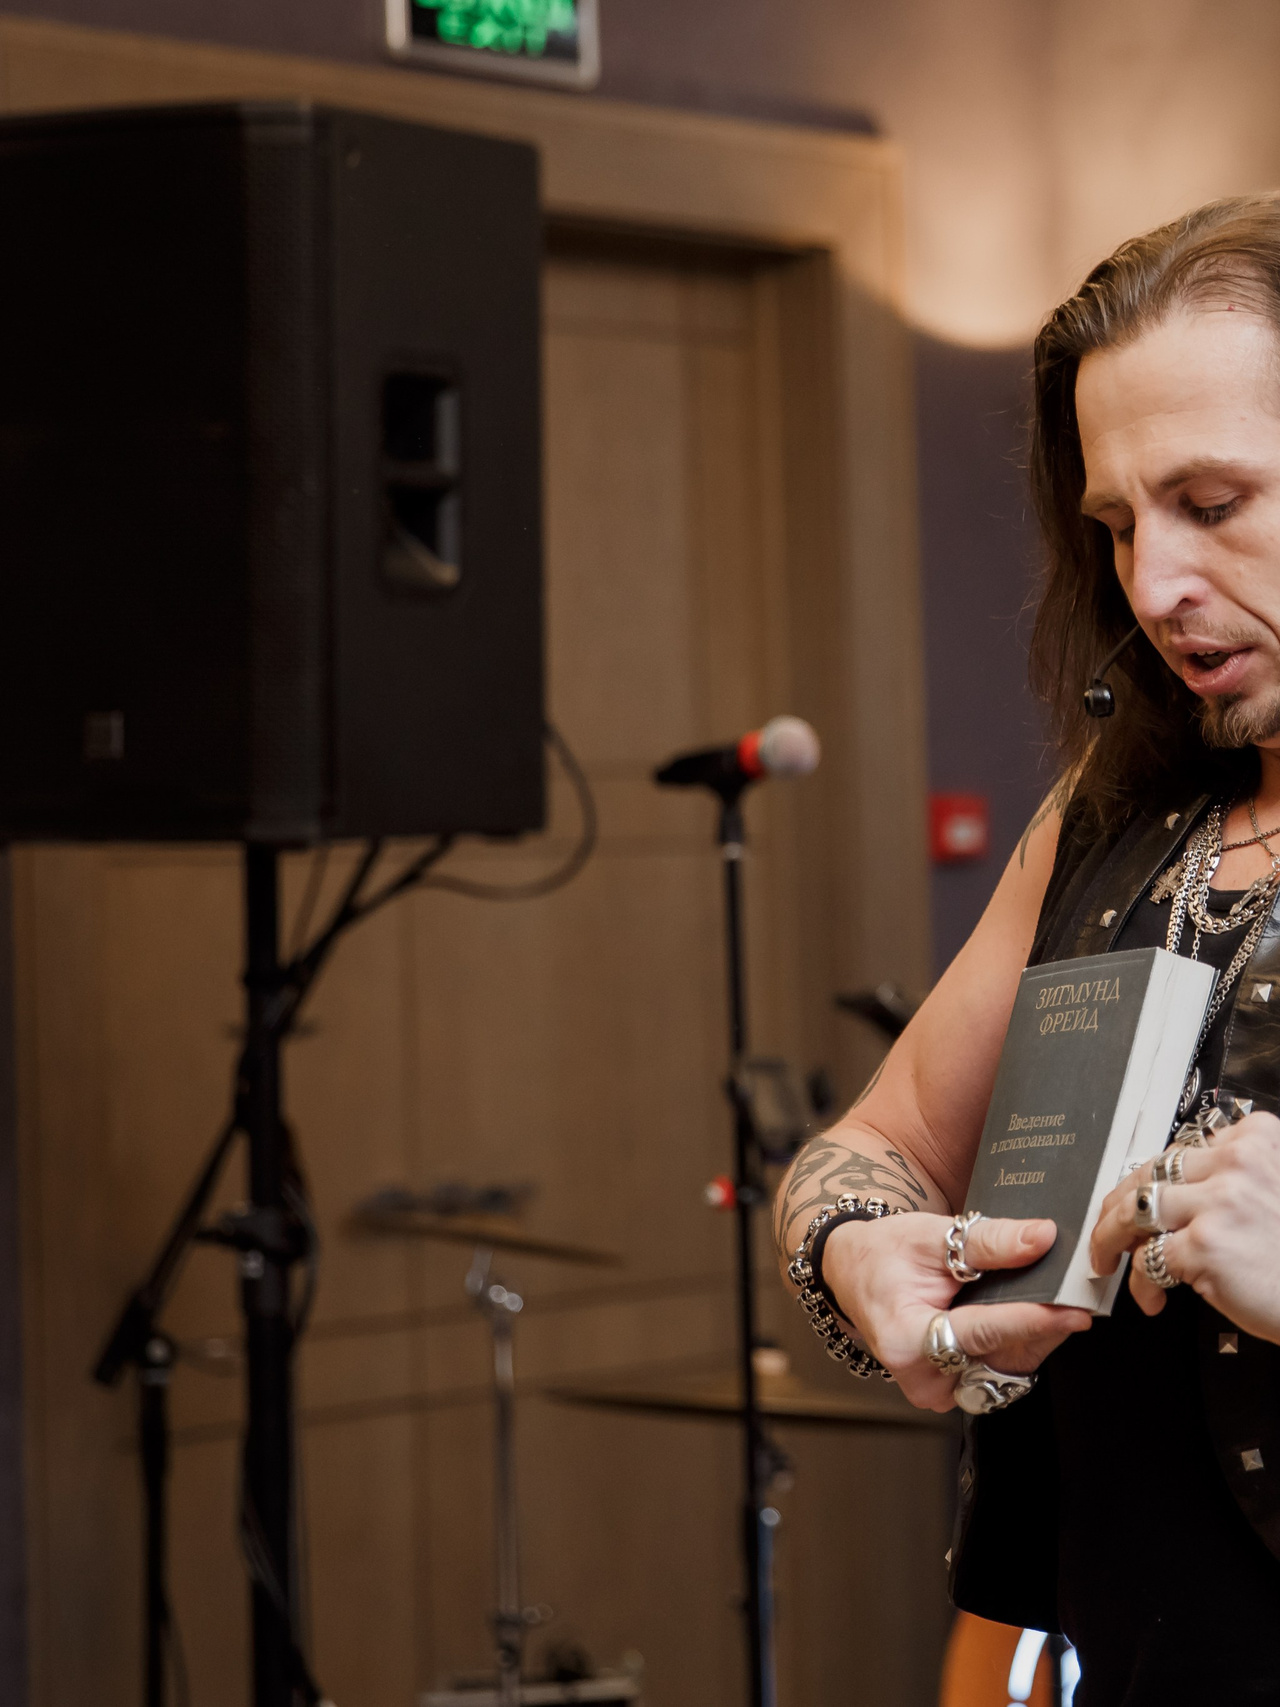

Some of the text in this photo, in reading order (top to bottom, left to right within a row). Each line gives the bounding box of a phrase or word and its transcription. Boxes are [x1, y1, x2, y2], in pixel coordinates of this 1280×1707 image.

[1035, 977, 1121, 1010] ЗИГМУНД
[1039, 1007, 1099, 1036] ФРЕЙД
[1007, 1113, 1066, 1132] Введение
[990, 1132, 1076, 1154] в психоанализ
[994, 1168, 1046, 1187] Лекции
